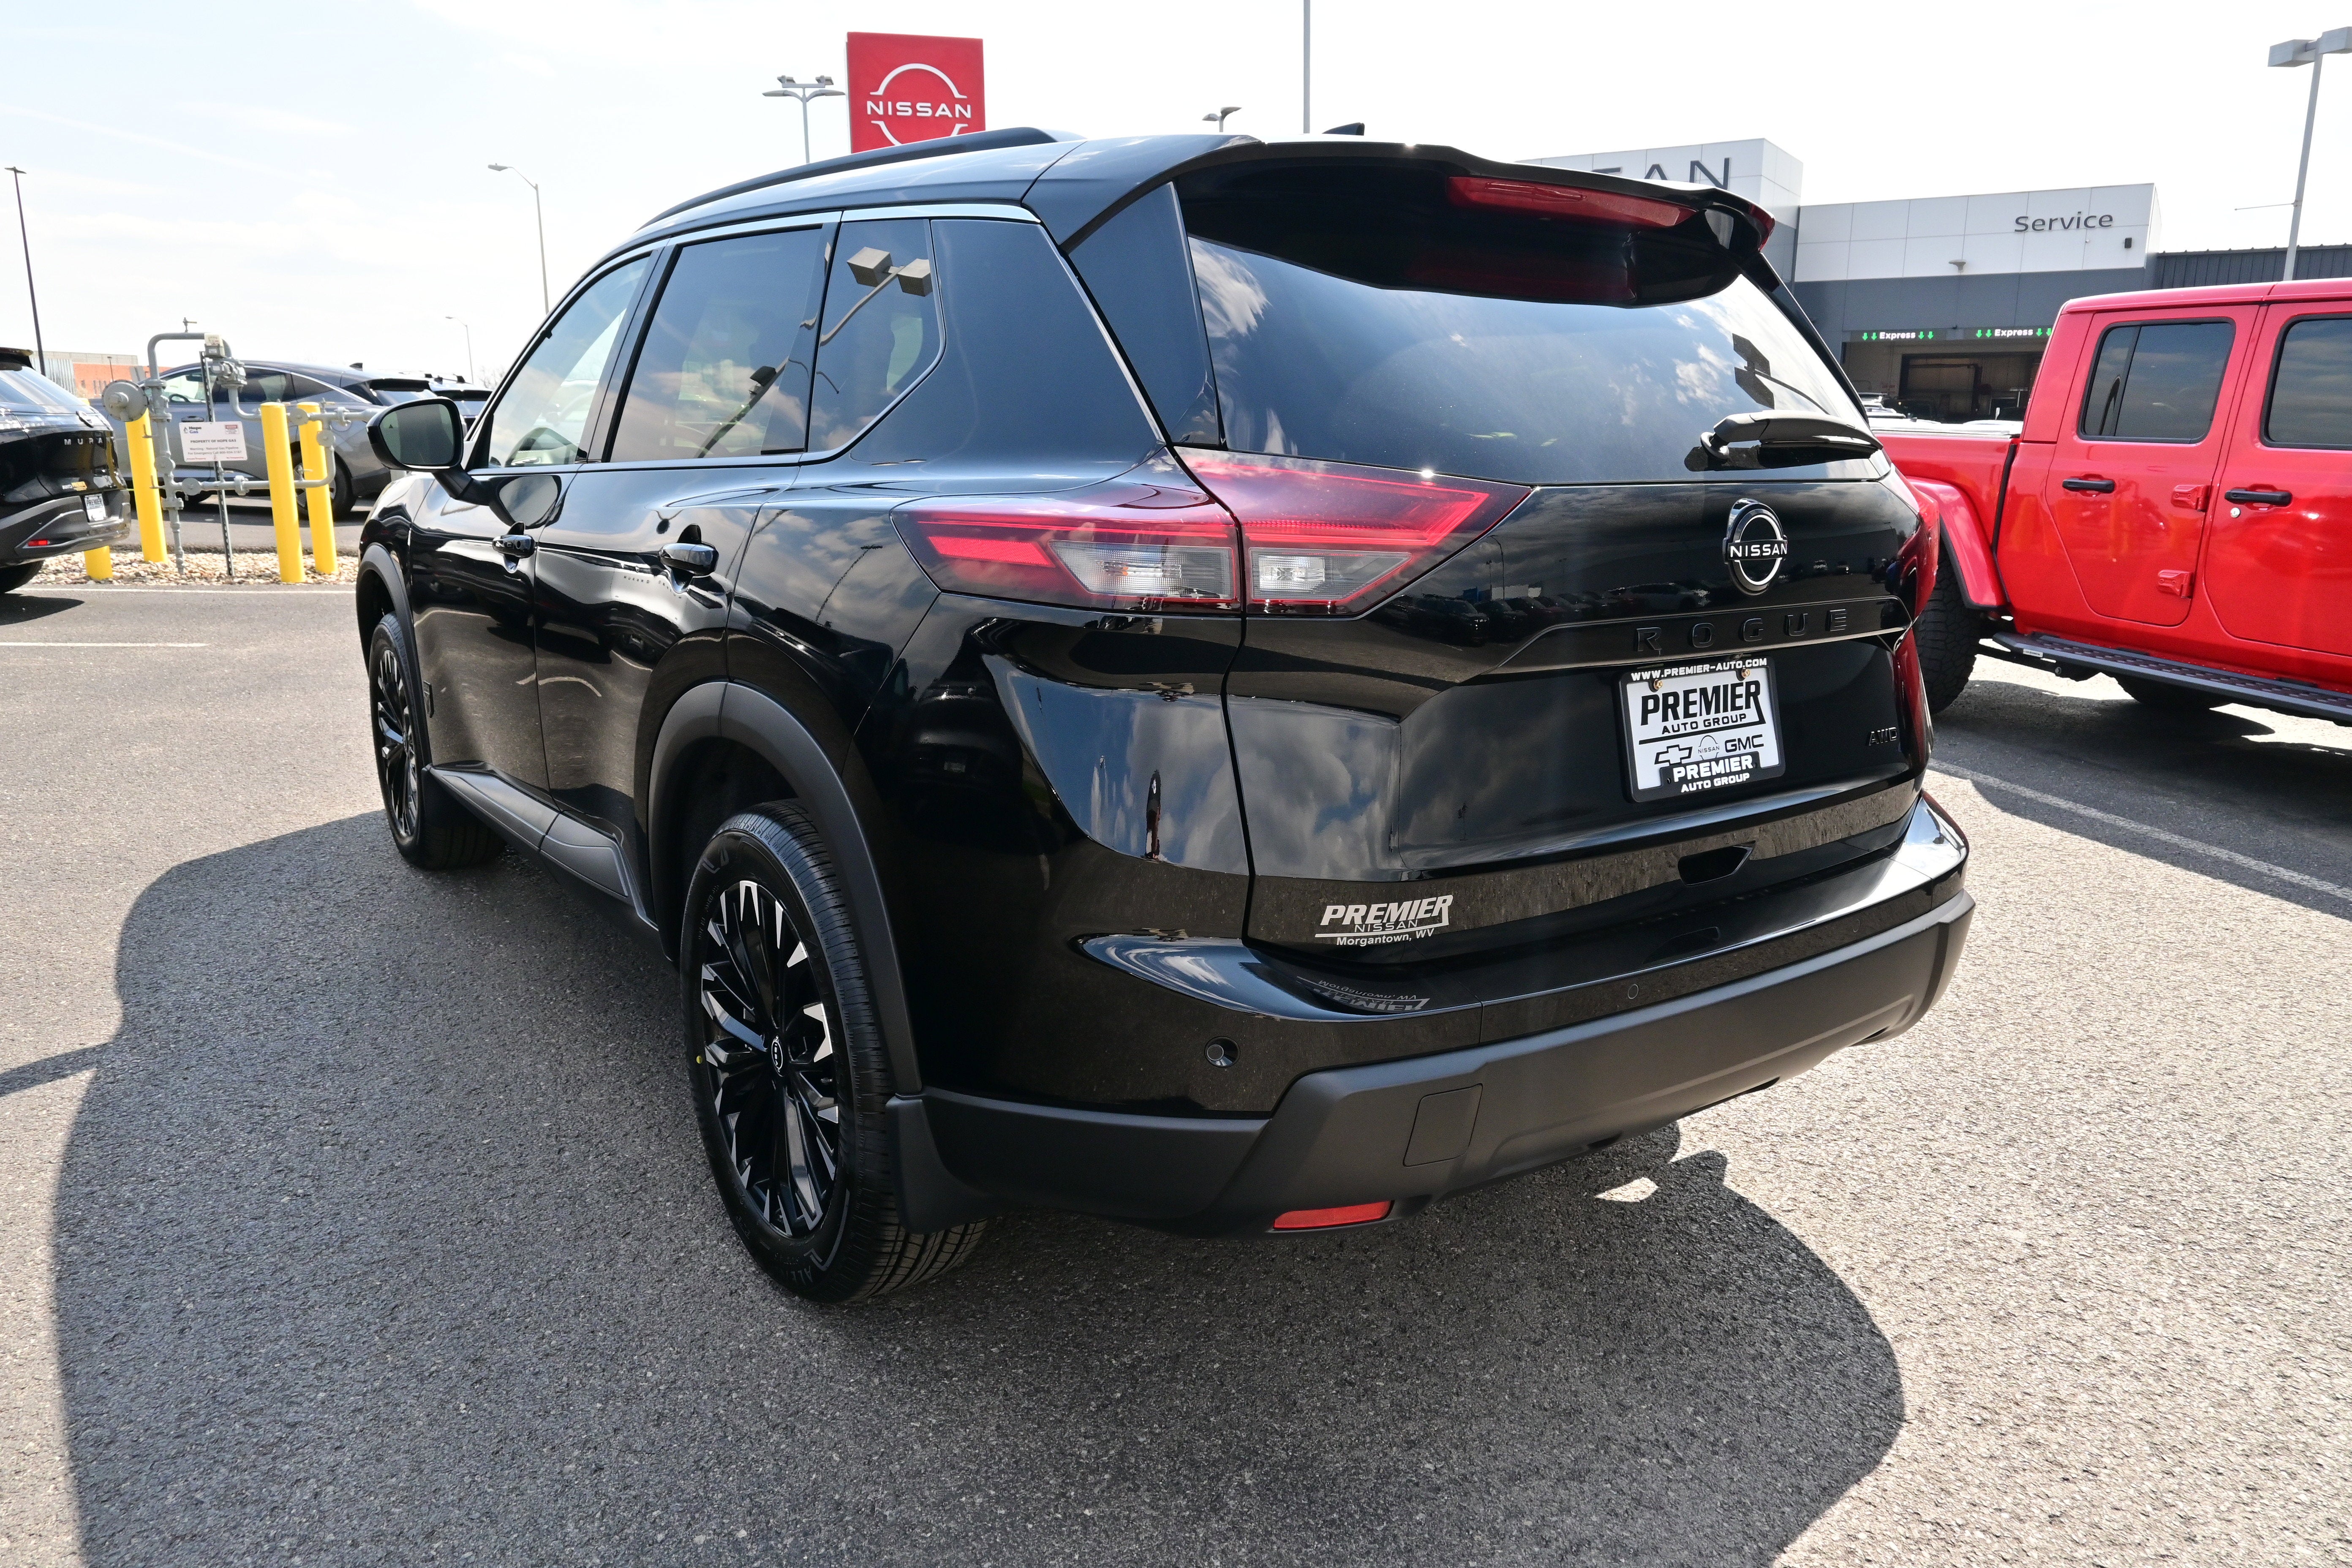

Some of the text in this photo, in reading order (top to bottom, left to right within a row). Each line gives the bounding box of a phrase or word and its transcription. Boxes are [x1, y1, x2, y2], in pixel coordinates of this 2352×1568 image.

[867, 101, 971, 118] NISSAN
[2014, 211, 2113, 232] Service
[1994, 329, 2033, 337] Express
[1730, 543, 1787, 558] NISSAN
[1636, 609, 1847, 652] ROGUE
[1631, 658, 1767, 681] WWW.PREMIER-AUTO.COM
[1641, 680, 1766, 726] PREMIER
[1661, 713, 1747, 735] AUTO GROUP
[1698, 734, 1764, 754] NISSAN GMC
[1867, 727, 1897, 746] AWD
[1673, 755, 1753, 782] PREMIER
[1681, 773, 1750, 793] AUTO GROUP
[1320, 895, 1454, 926] PREMIER
[1354, 919, 1418, 933] NISSAN
[1337, 928, 1435, 947] Morgantown, WV
